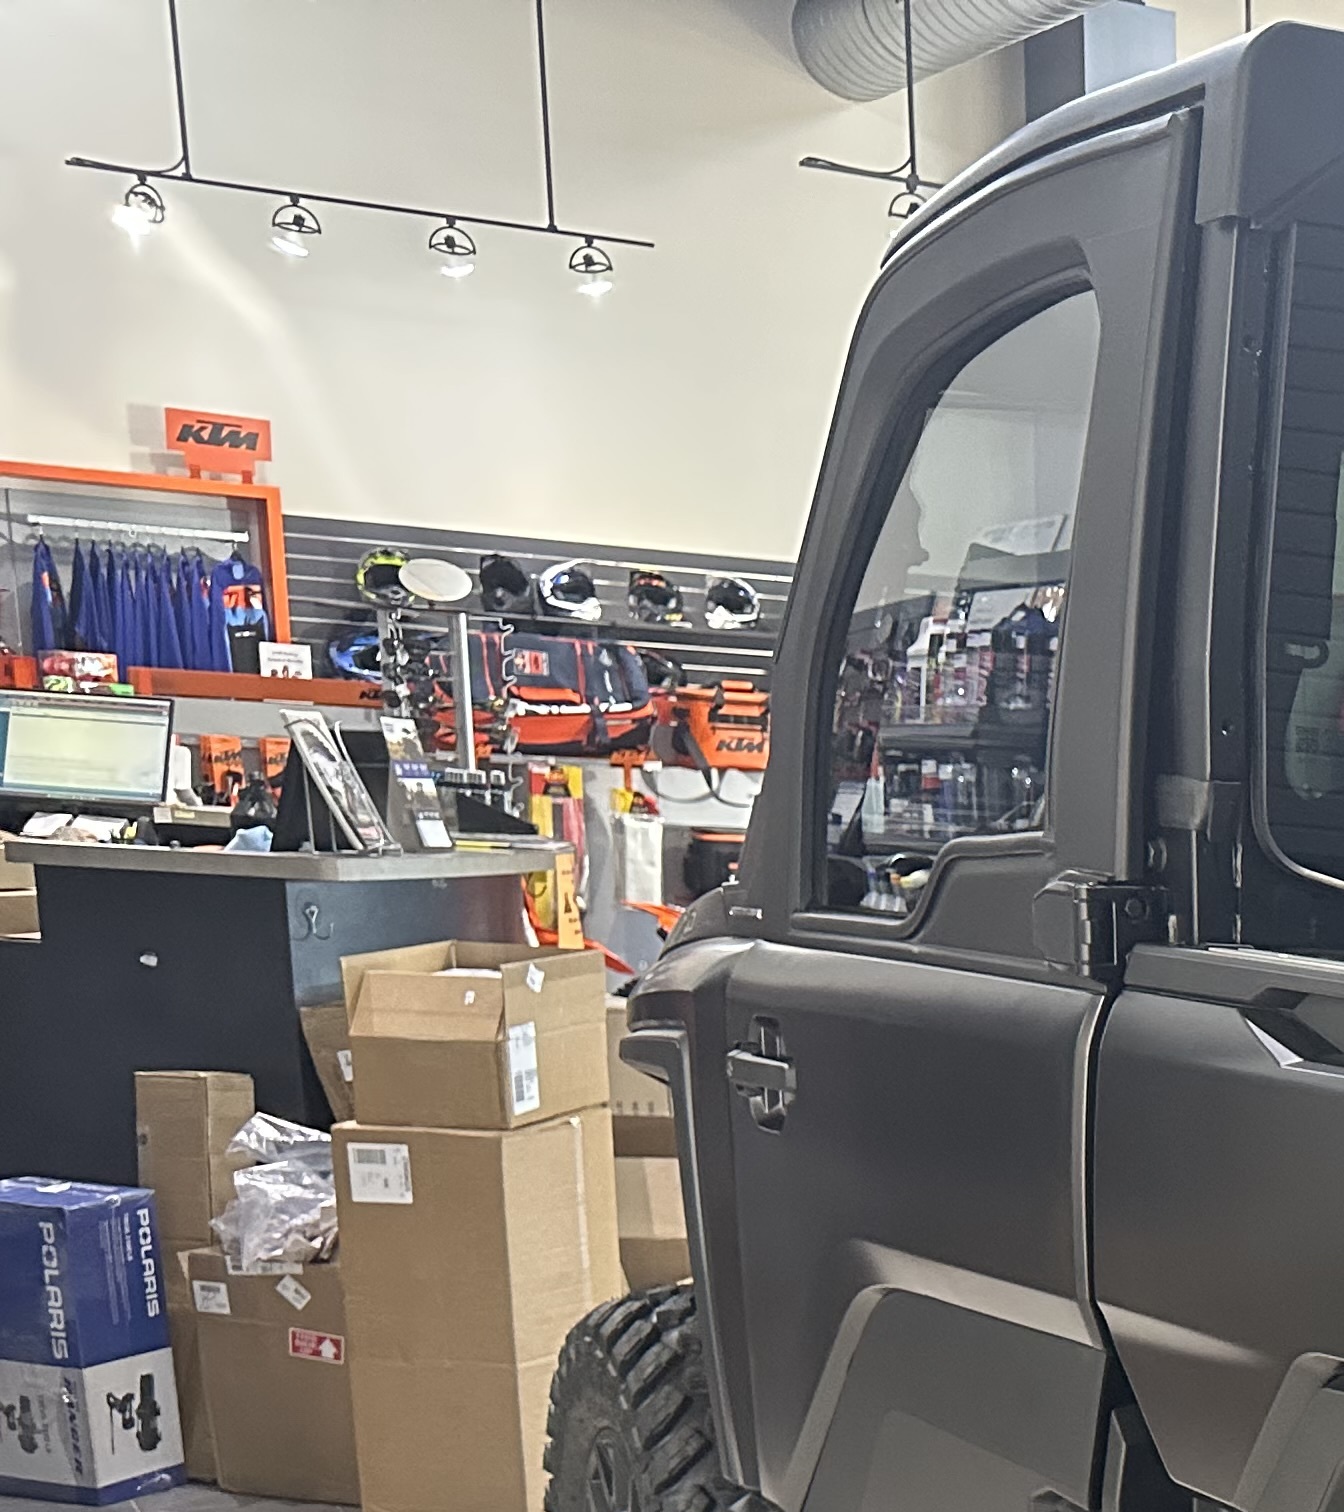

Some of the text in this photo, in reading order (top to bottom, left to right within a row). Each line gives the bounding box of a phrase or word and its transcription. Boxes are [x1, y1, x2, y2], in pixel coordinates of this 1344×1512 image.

[176, 419, 259, 451] KTM
[716, 736, 764, 754] KTM
[38, 1221, 69, 1360] POLARIS
[136, 1207, 160, 1318] POLARIS
